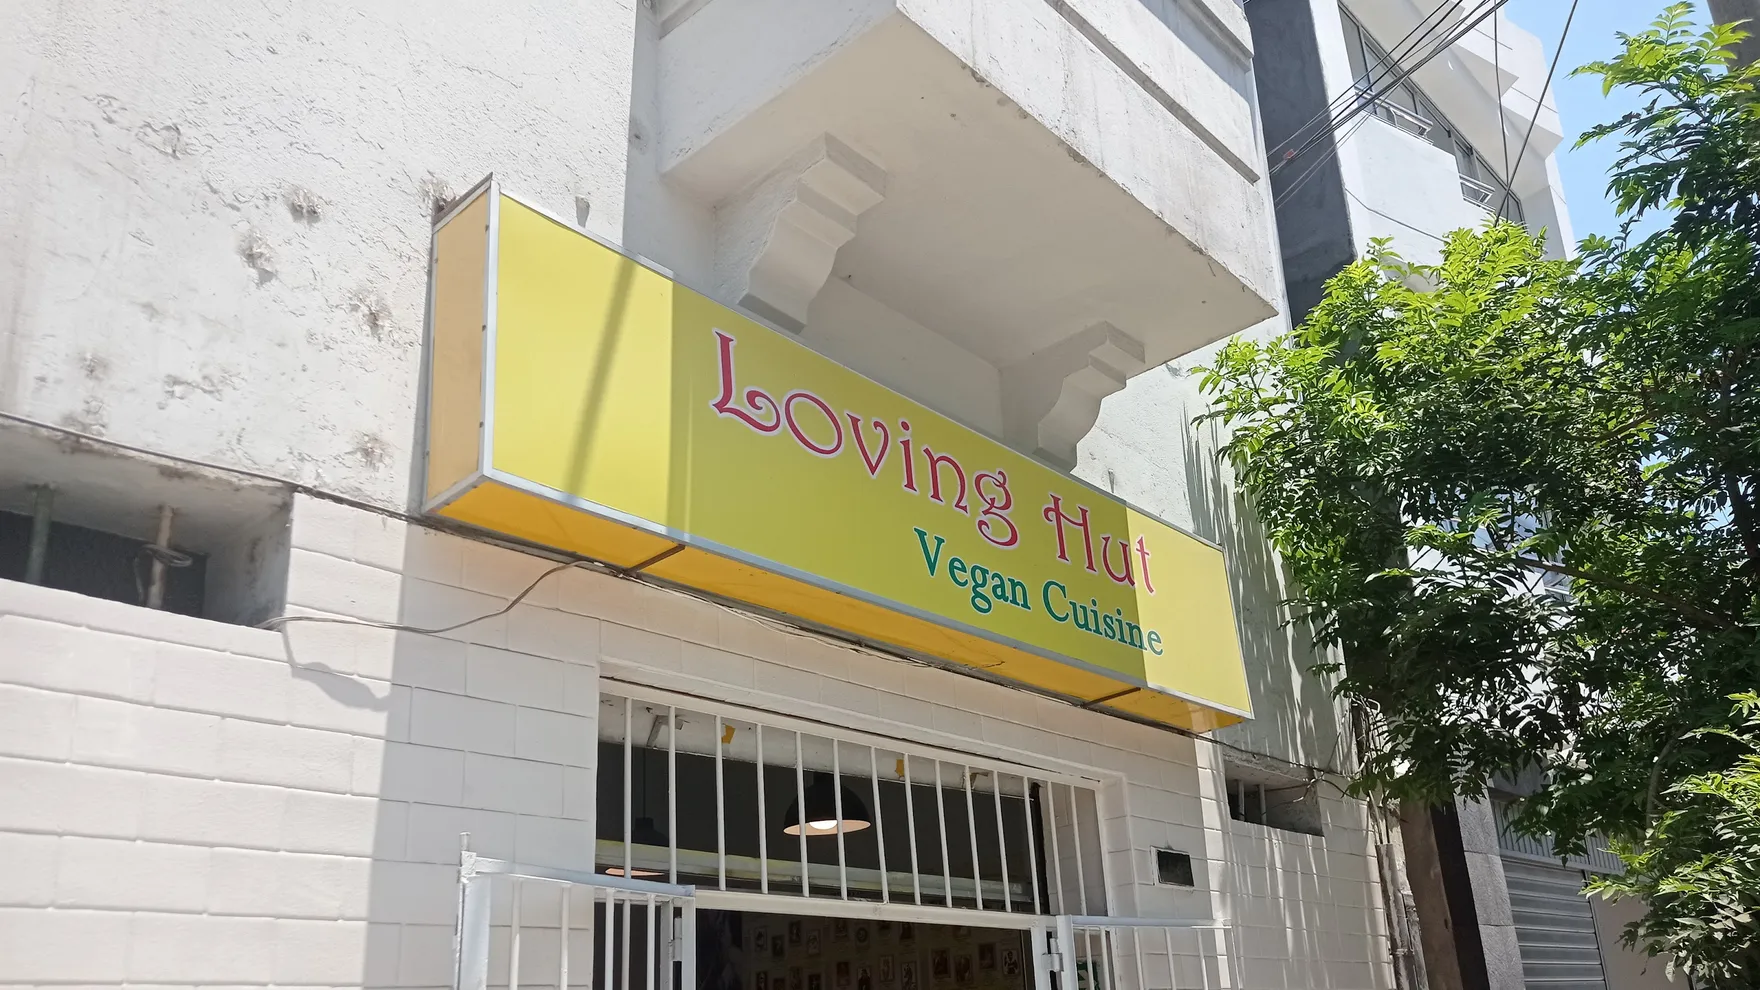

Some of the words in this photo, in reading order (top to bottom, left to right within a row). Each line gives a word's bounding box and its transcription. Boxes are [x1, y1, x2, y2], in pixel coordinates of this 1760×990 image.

[711, 329, 1019, 547] Loving
[1043, 494, 1155, 594] Hut
[913, 527, 1032, 614] Vegan
[1043, 579, 1164, 656] Cuisine
